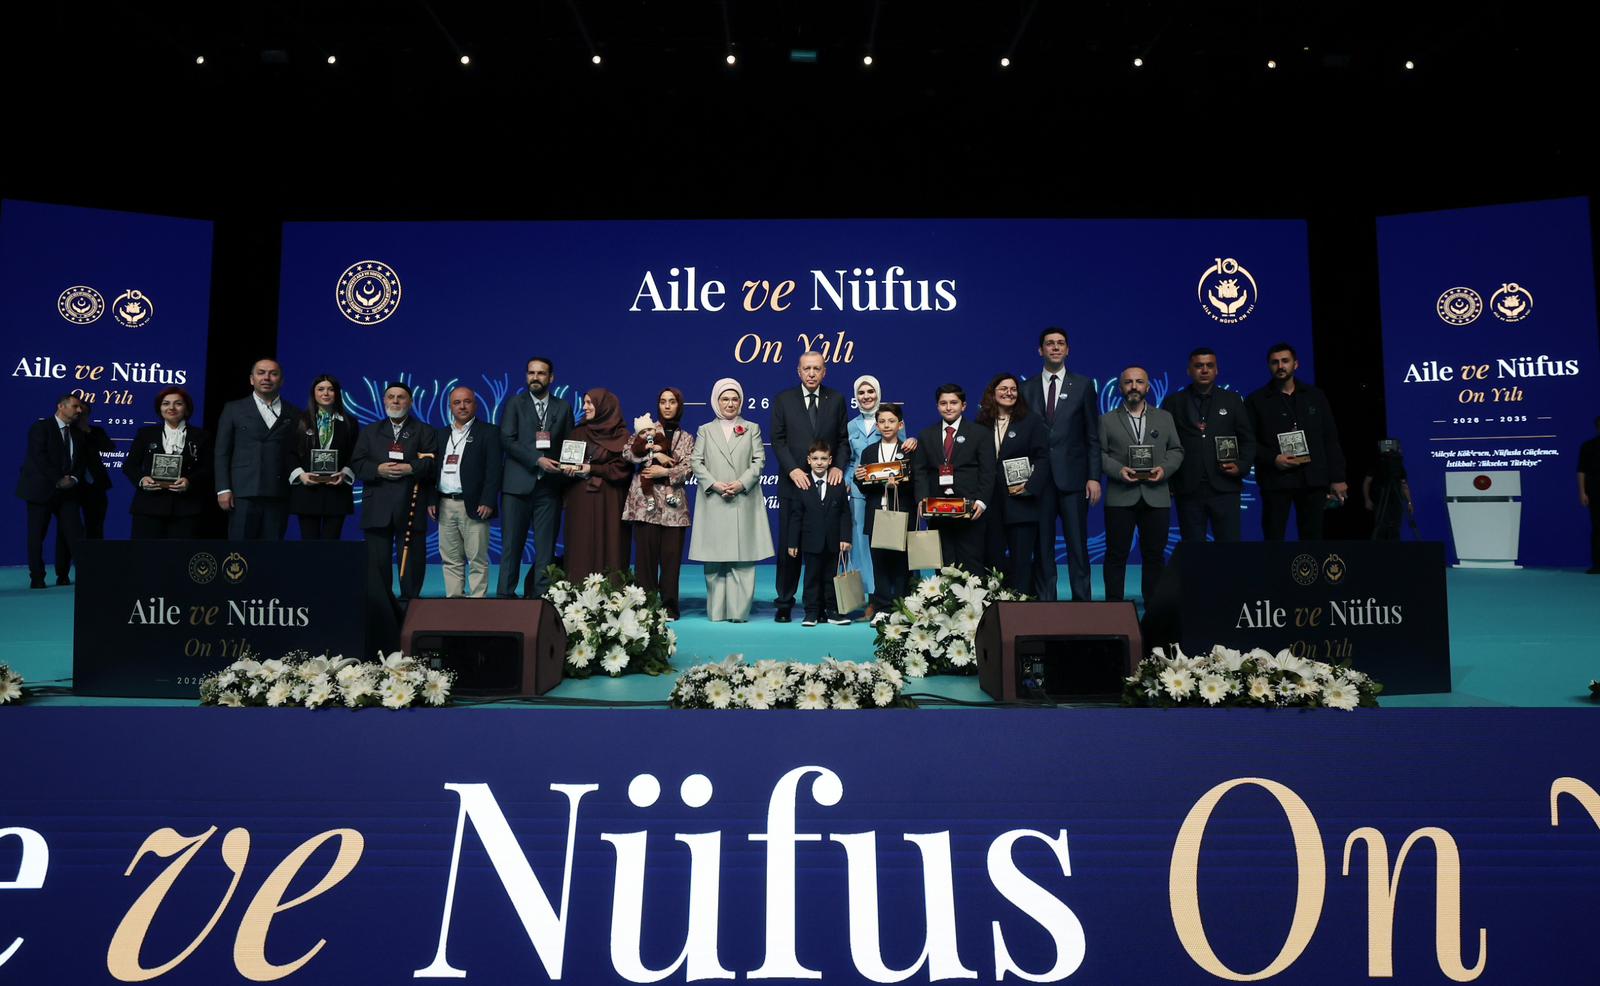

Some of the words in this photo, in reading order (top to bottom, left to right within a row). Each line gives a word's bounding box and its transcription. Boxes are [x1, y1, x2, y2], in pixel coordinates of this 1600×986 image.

[1215, 258, 1239, 274] 10
[629, 267, 726, 312] Aile
[741, 279, 796, 312] ve
[810, 265, 957, 312] Nüfus
[734, 333, 783, 364] On
[797, 330, 854, 364] Yılı
[12, 356, 67, 379] Aile
[74, 364, 105, 381] ve
[111, 361, 187, 385] Nüfus
[1403, 360, 1454, 383] Aile
[1460, 364, 1490, 381] ve
[1496, 354, 1580, 379] Nüfus
[103, 389, 133, 405] Yılı
[1458, 389, 1485, 404] On
[1491, 385, 1524, 402] Yılı
[1500, 415, 1528, 423] 2035
[127, 597, 181, 625] Aile
[189, 605, 220, 626] ve
[227, 597, 309, 627] Nüfus
[1235, 600, 1287, 629] Aile
[1294, 607, 1323, 628] ve
[1329, 597, 1403, 626] Nüfus
[184, 638, 212, 657] On
[1292, 640, 1317, 659] On
[106, 824, 365, 983] ve
[412, 764, 1087, 984] Nüfus
[1168, 776, 1488, 983] On
